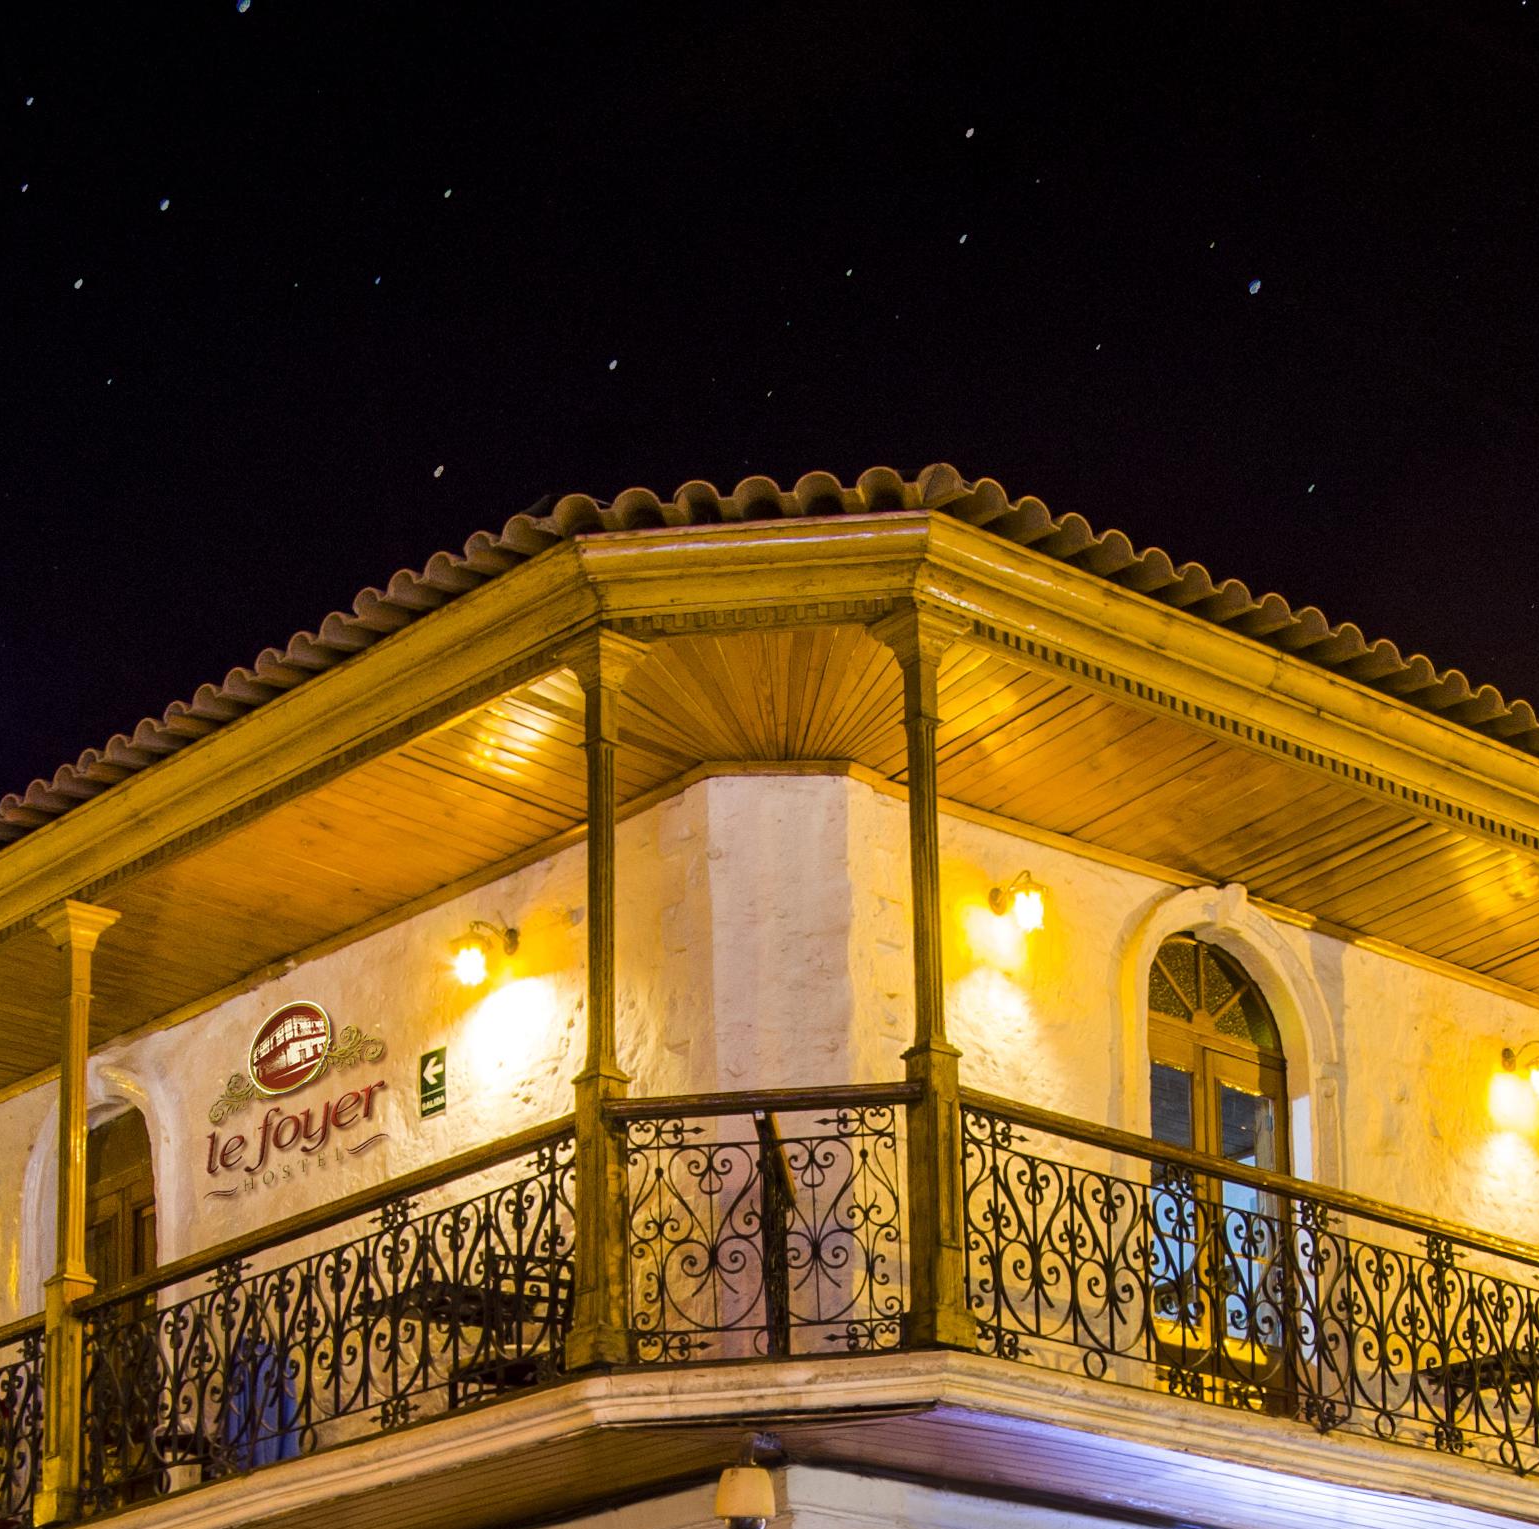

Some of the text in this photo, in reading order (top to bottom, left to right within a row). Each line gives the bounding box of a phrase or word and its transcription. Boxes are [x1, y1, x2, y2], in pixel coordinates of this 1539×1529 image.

[421, 1095, 445, 1112] SALIDA
[207, 1080, 385, 1174] le foyer
[243, 1148, 344, 1192] HOSTEL
